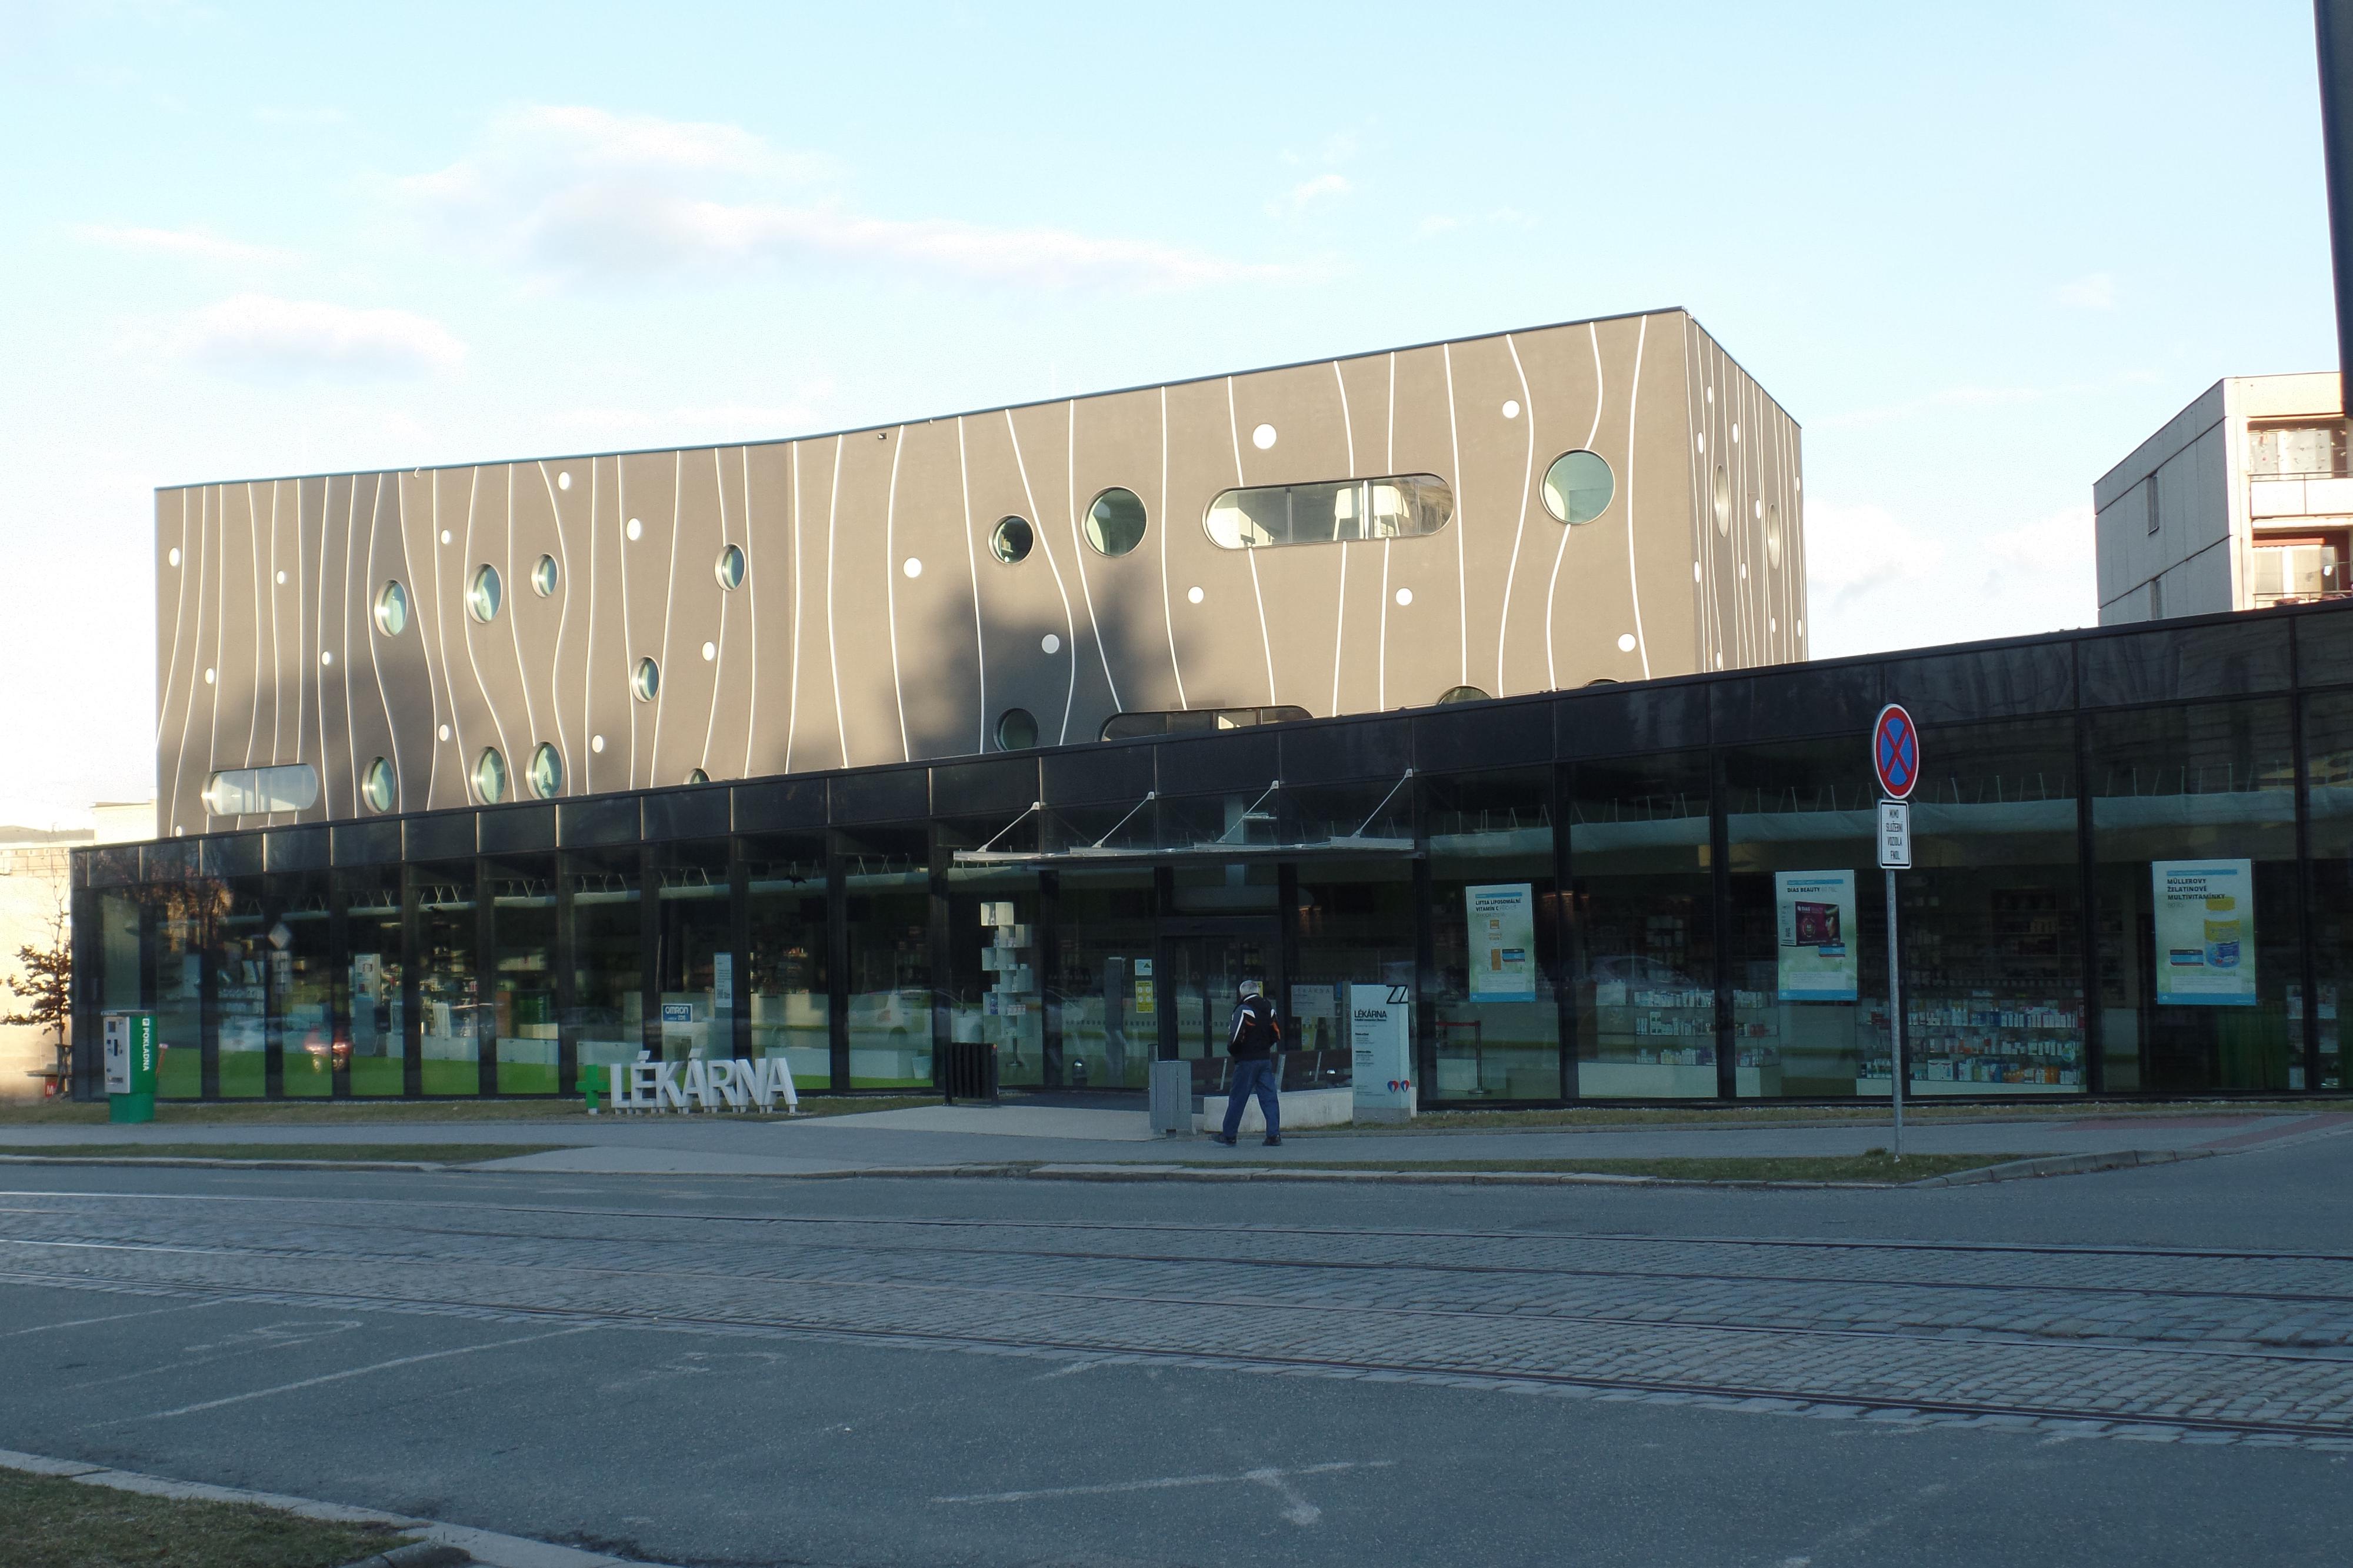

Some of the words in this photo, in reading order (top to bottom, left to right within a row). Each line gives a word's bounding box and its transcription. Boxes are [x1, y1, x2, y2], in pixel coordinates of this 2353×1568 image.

[1889, 809, 1899, 818] MIMO
[1887, 836, 1902, 846] VOZIDLA
[1354, 1009, 1387, 1018] LÉKÁRNA
[610, 1048, 798, 1109] LÉKÁRNA
